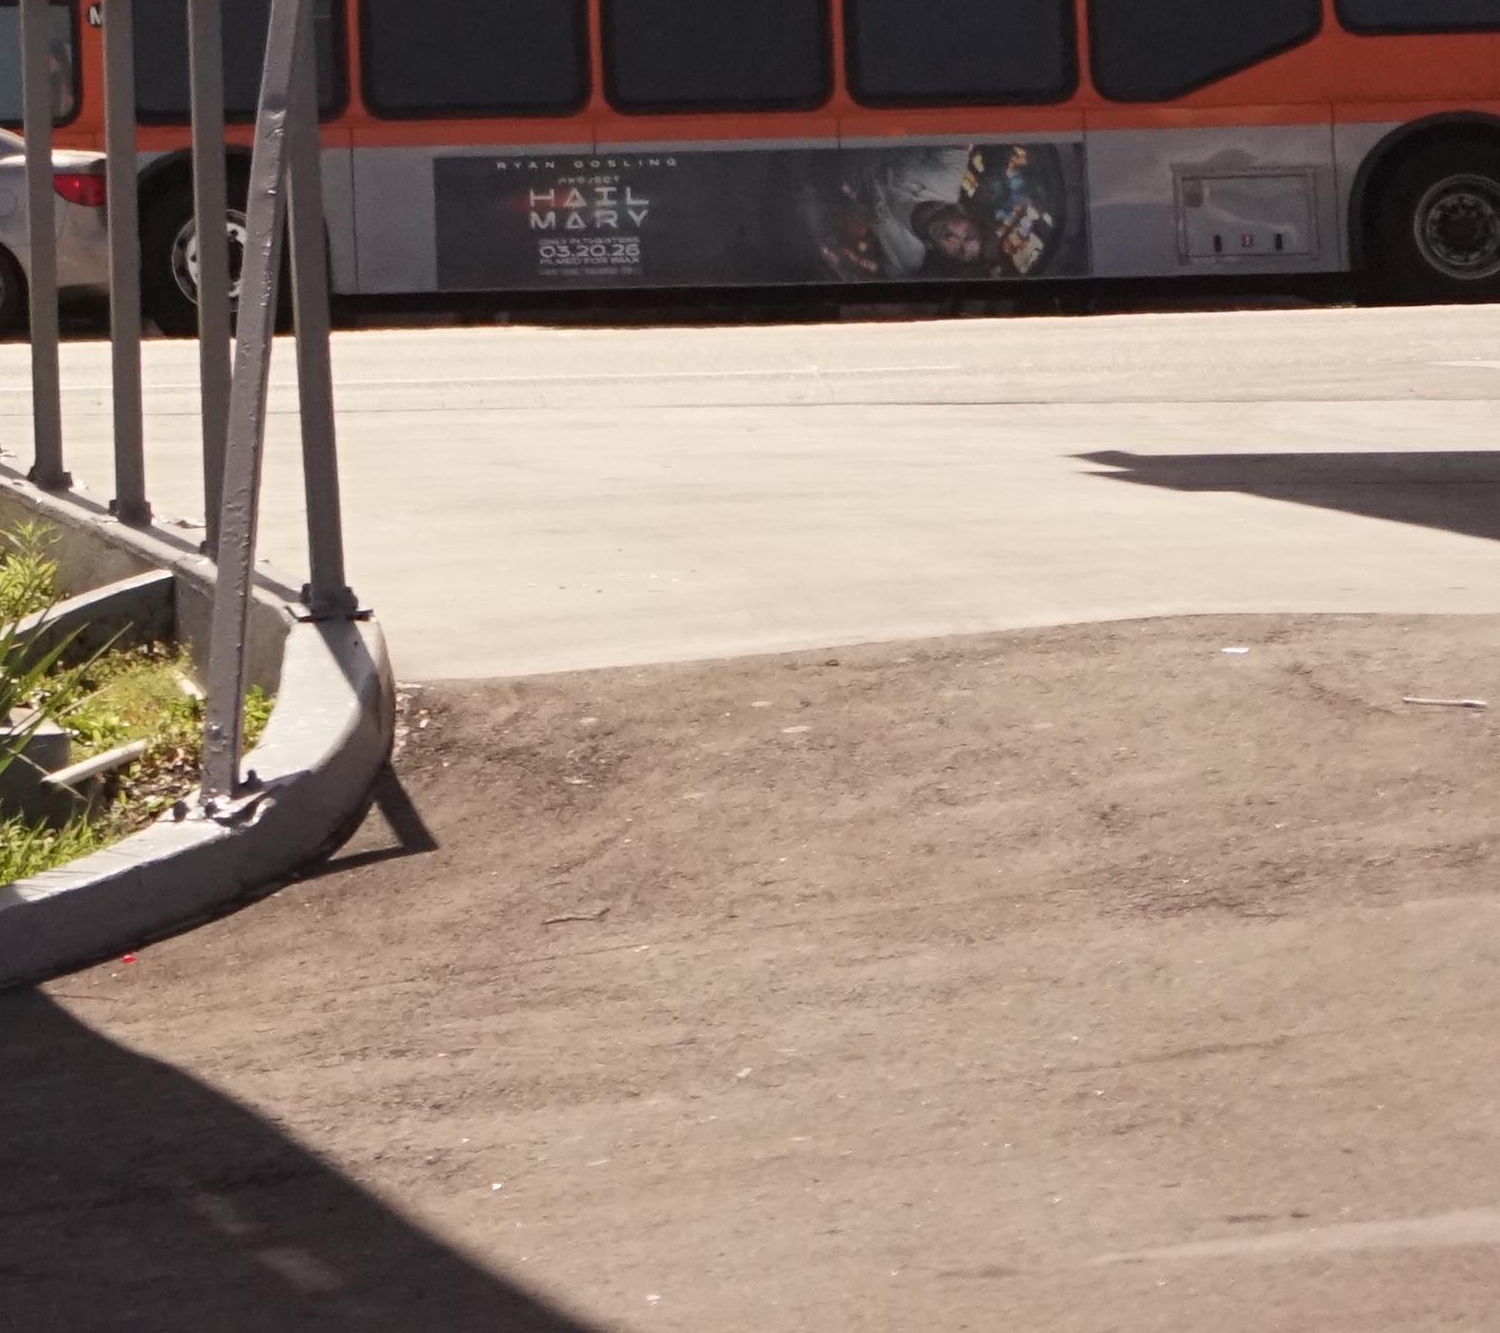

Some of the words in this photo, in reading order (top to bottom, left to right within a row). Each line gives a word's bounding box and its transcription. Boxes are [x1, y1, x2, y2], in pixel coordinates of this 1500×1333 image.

[496, 160, 556, 171] RYAN
[573, 157, 678, 169] GOSLING
[528, 186, 651, 208] HAIL
[528, 209, 650, 231] MARY
[538, 243, 642, 259] 03.20.26
